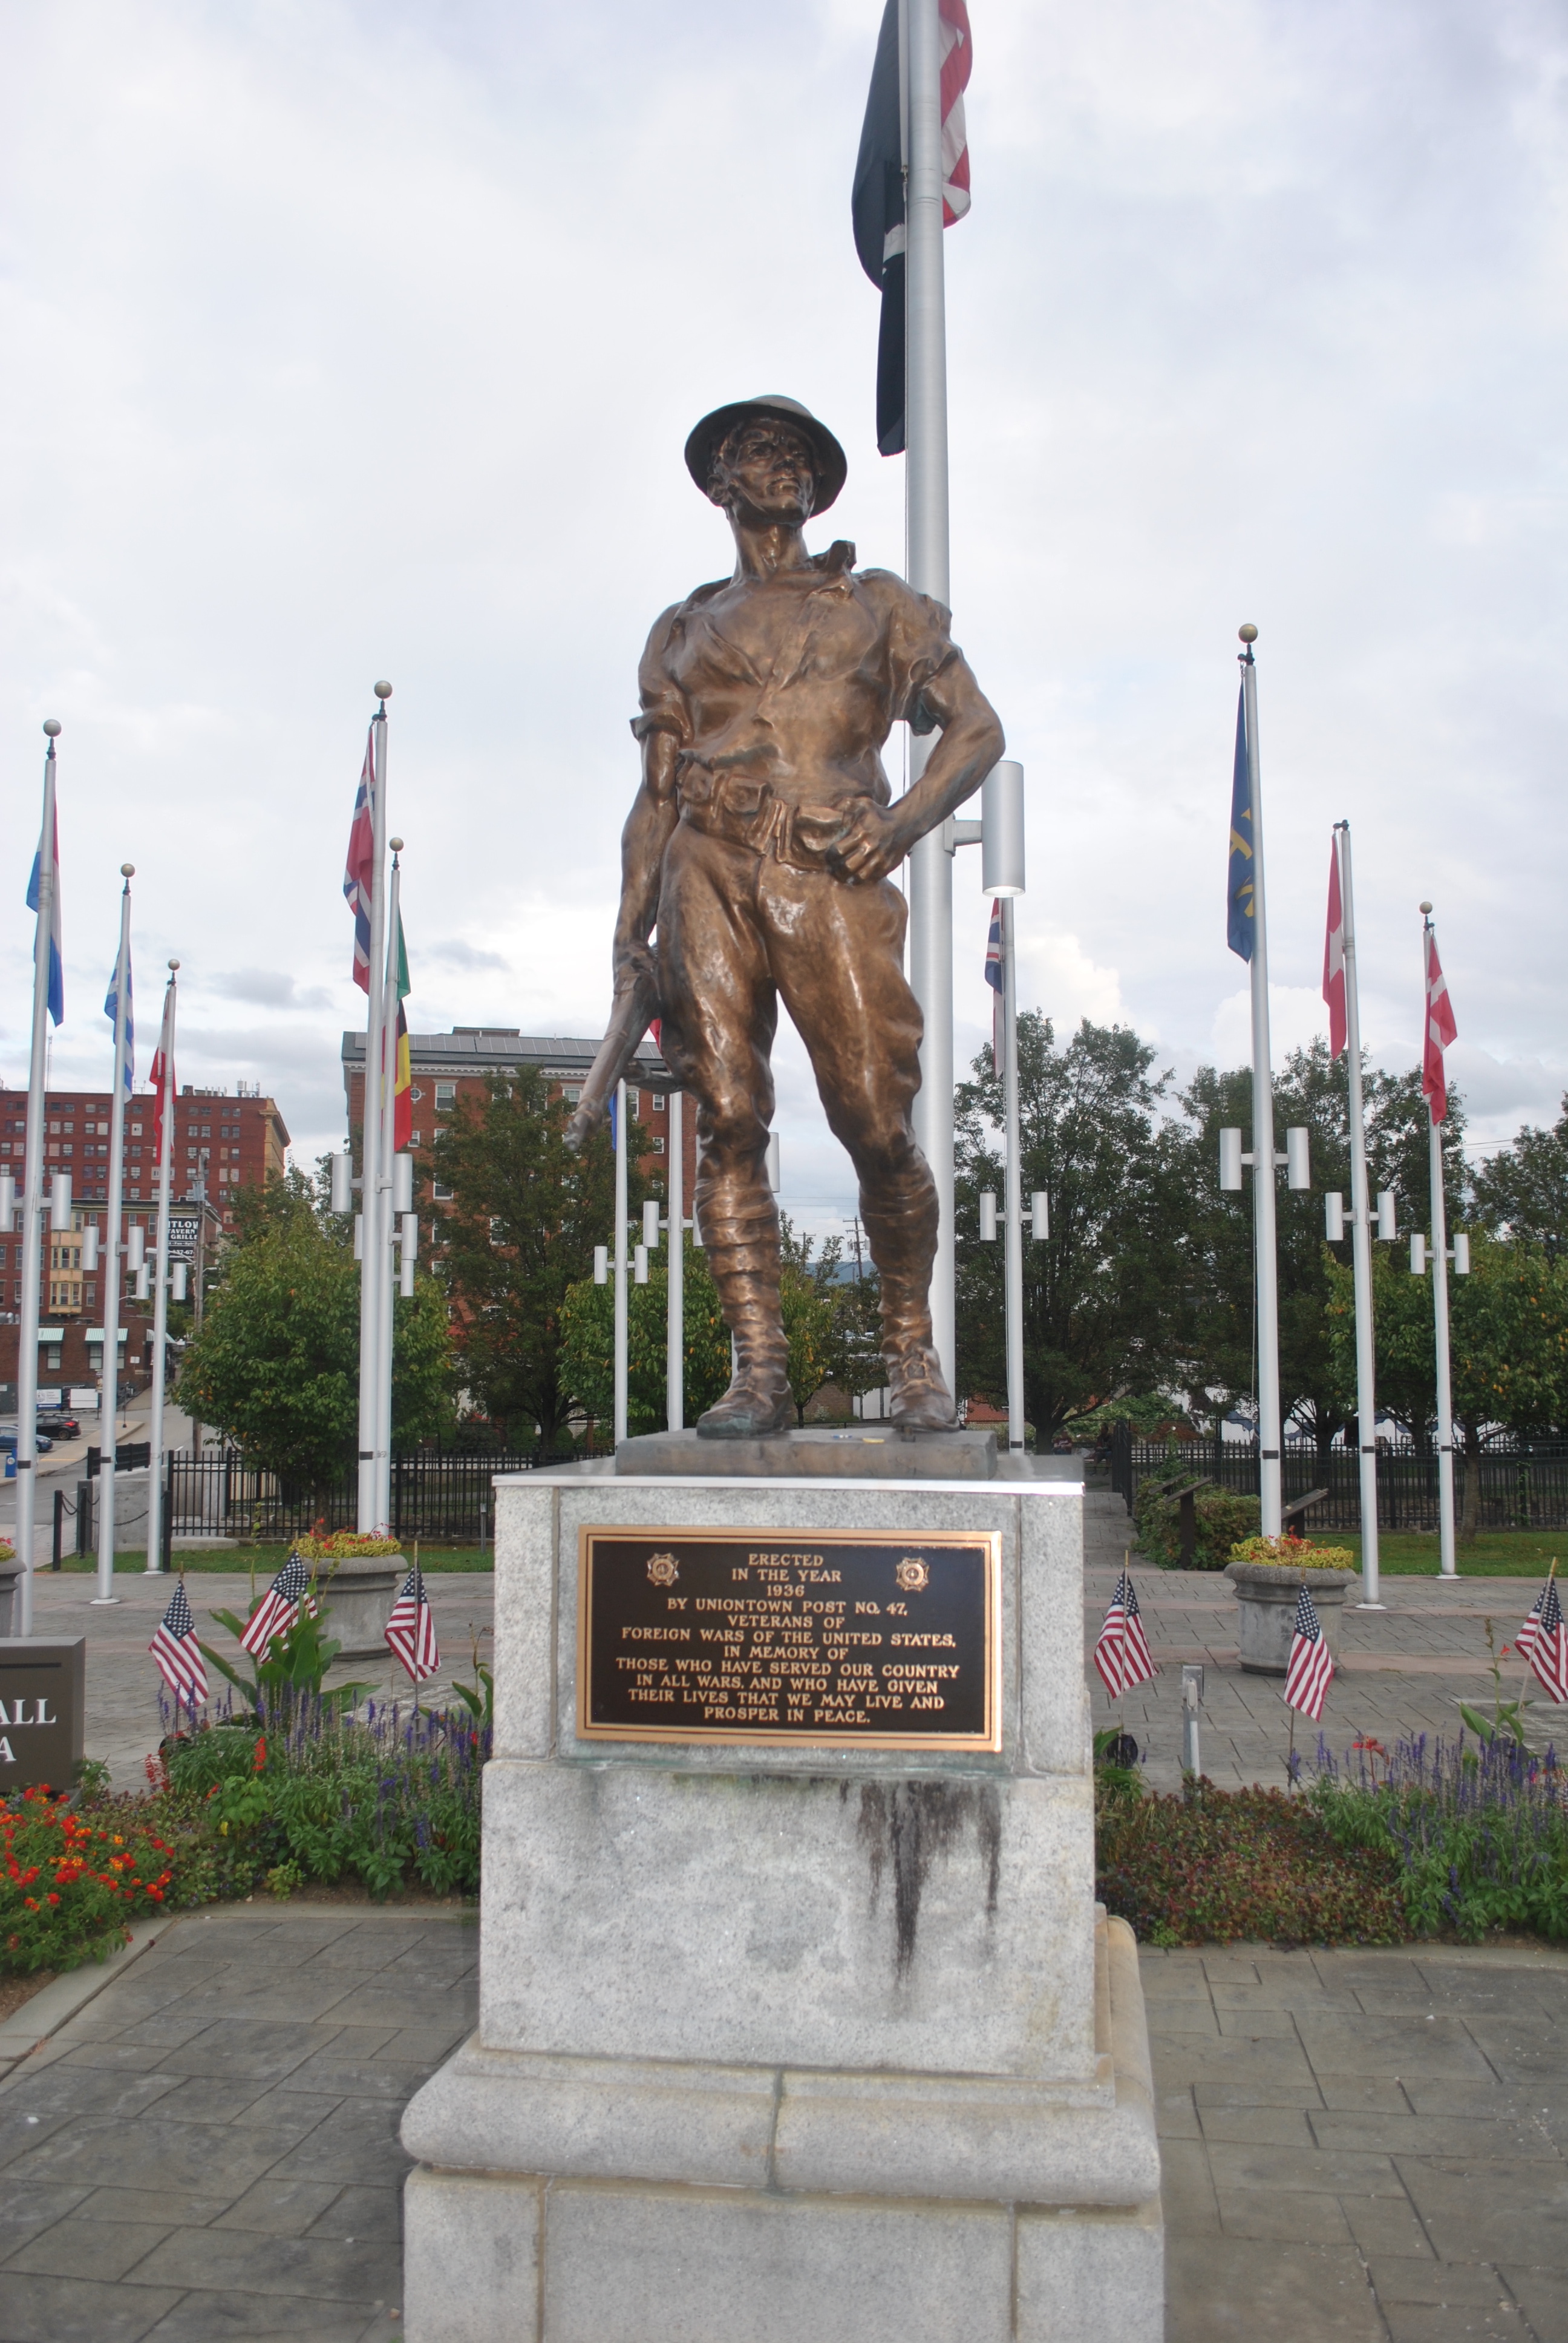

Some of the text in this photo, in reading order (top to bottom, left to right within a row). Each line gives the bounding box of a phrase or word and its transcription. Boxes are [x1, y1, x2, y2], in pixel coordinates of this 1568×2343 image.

[748, 1553, 824, 1567] ERECTED
[732, 1568, 841, 1582] IN THE YEAR
[767, 1584, 805, 1598] 1936
[667, 1598, 688, 1610] BY
[696, 1598, 792, 1613] UNIONTOWN
[803, 1601, 846, 1614] POST
[727, 1614, 845, 1630] VETERANS OF
[622, 1627, 691, 1641] FOREIGN
[699, 1628, 745, 1643] WARS
[753, 1631, 775, 1643] OF
[781, 1631, 814, 1644] THE
[823, 1632, 883, 1645] UNITED
[724, 1645, 849, 1660] IN MEMORY OF
[616, 1657, 960, 1679] THOSE WHO HAVE SERVED OUR COUNTRY
[636, 1674, 653, 1686] IN
[660, 1674, 690, 1688] ALL
[749, 1677, 782, 1690] AND
[789, 1677, 828, 1691] WHO
[837, 1679, 879, 1693] HAVE
[887, 1679, 938, 1694] GIVEN
[628, 1688, 945, 1709] THEIR LIVES THAT WE MAY LIVE AND
[704, 1706, 779, 1722] PROSPER
[787, 1708, 804, 1722] IN
